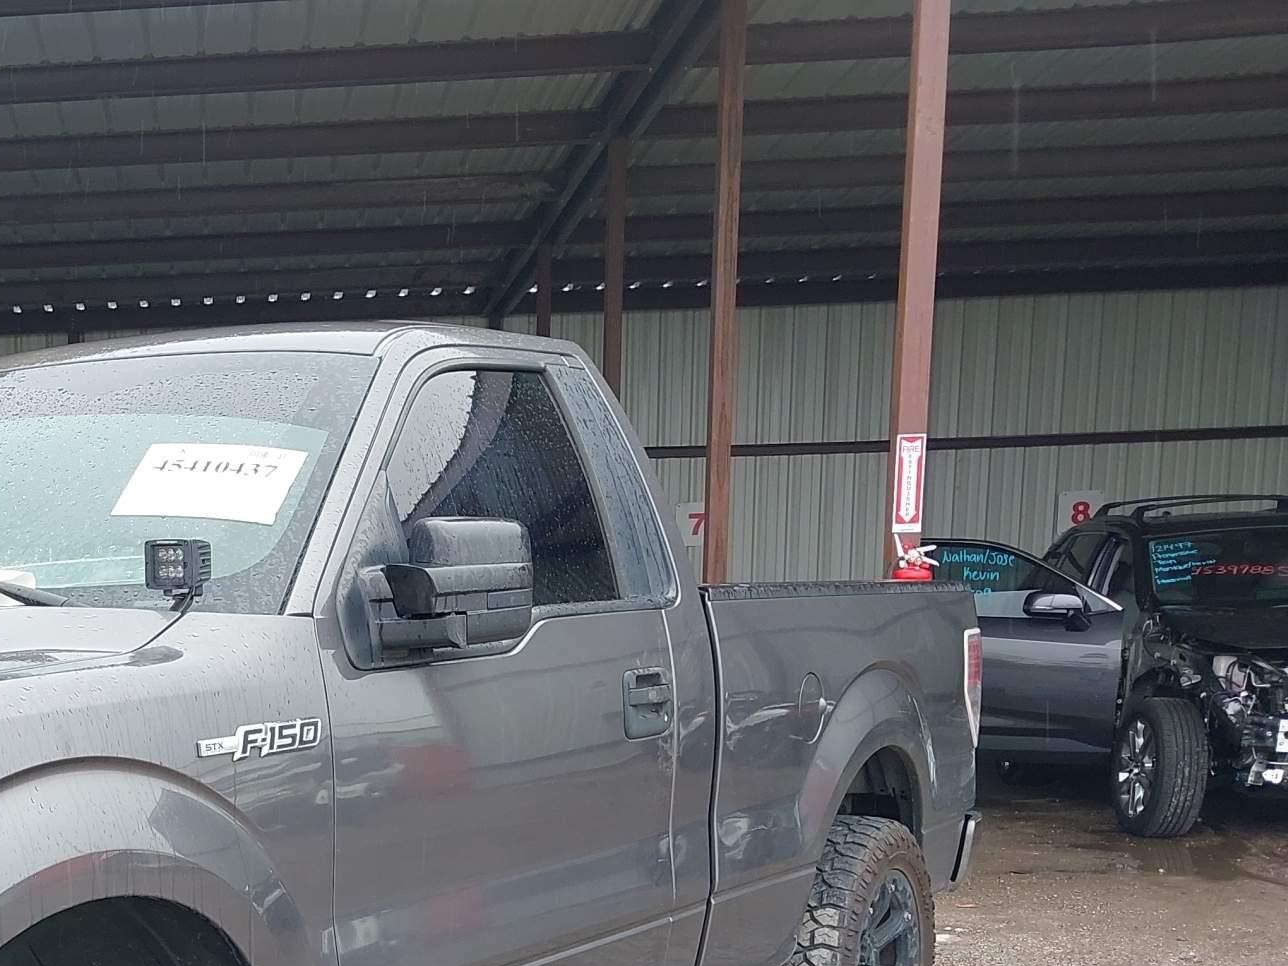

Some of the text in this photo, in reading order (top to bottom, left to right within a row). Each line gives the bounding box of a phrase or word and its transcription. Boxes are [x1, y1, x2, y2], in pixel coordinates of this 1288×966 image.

[902, 445, 920, 453] FIRE
[153, 459, 278, 478] 45410437
[1071, 501, 1090, 525] 8
[688, 513, 706, 536] 7
[963, 567, 1000, 582] Kevin
[205, 718, 321, 761] STX F-150
